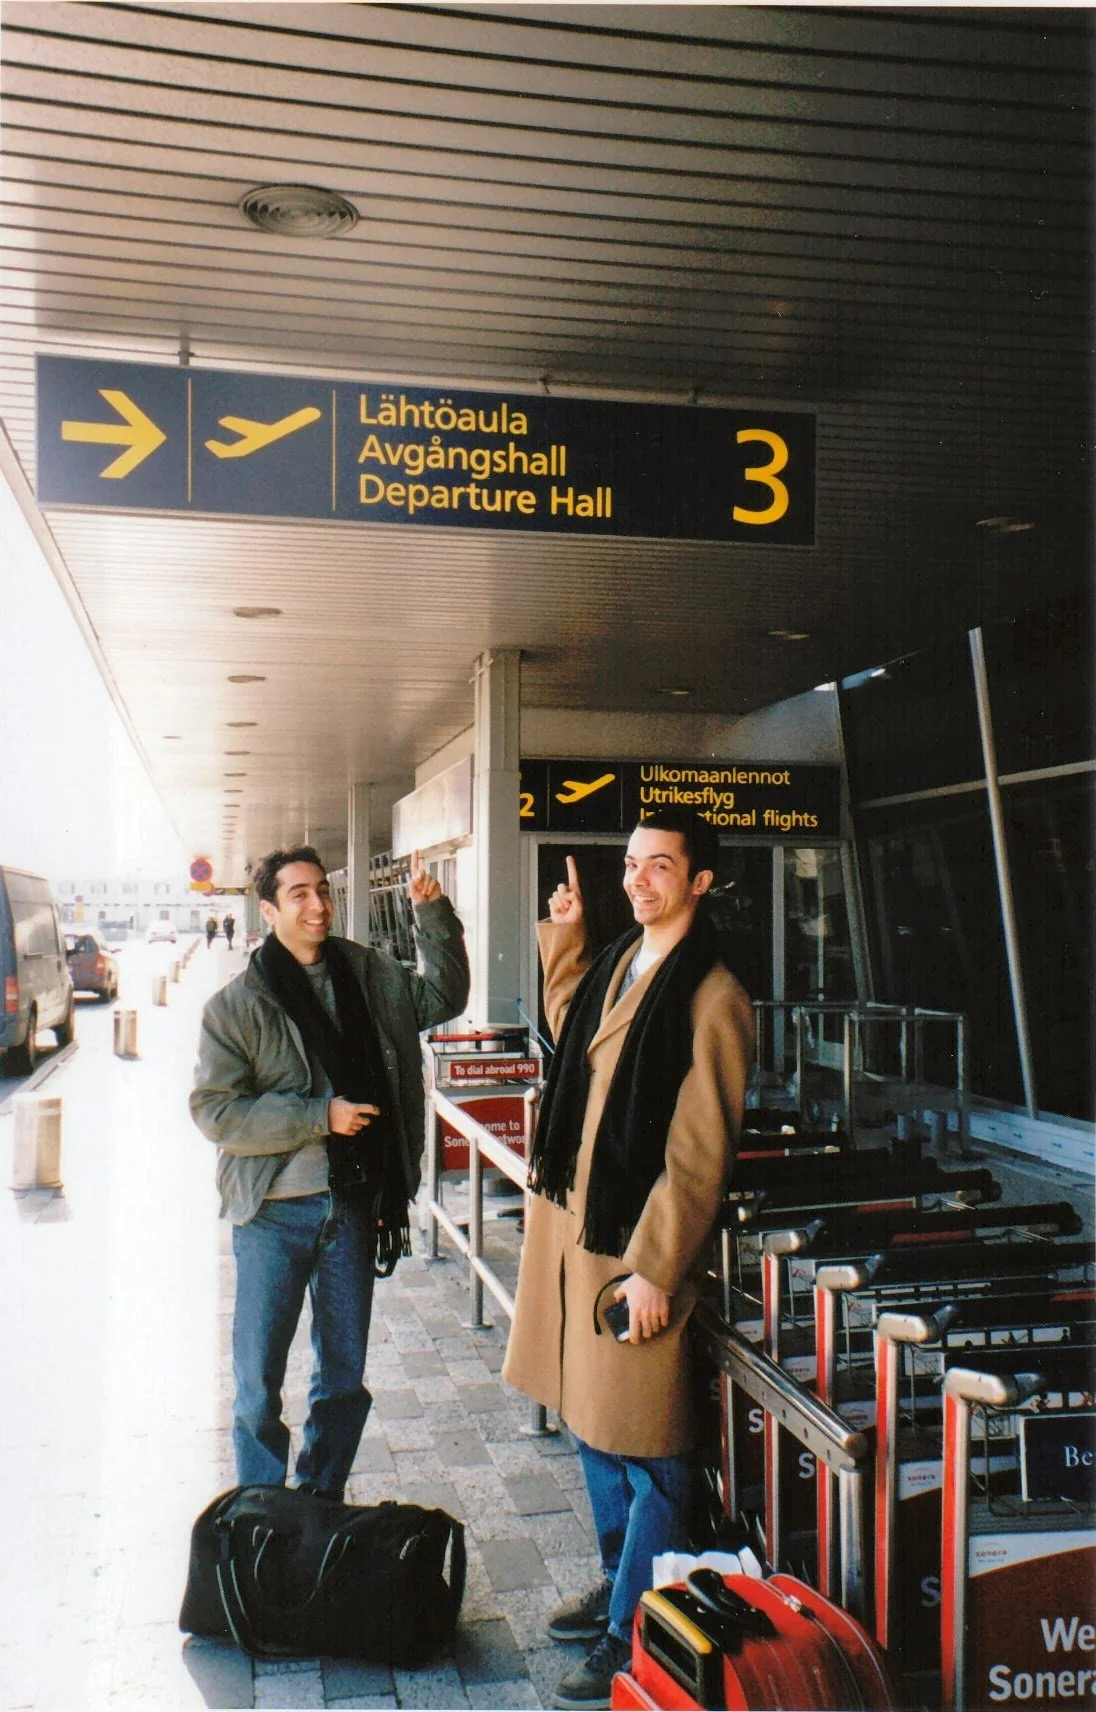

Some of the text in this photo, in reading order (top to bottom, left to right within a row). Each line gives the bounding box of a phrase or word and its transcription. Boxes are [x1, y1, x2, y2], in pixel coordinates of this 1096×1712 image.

[359, 394, 528, 435] Lähtöaula
[358, 434, 566, 480] Avgångshall
[733, 428, 789, 525] 3
[359, 474, 612, 518] Departure Hall
[640, 765, 790, 785] Ulkomaanlennot
[640, 786, 734, 809] Utrikesflyg
[640, 808, 818, 831] Itional flights
[454, 1063, 535, 1076] To dial abroad 990
[508, 1119, 520, 1131] to
